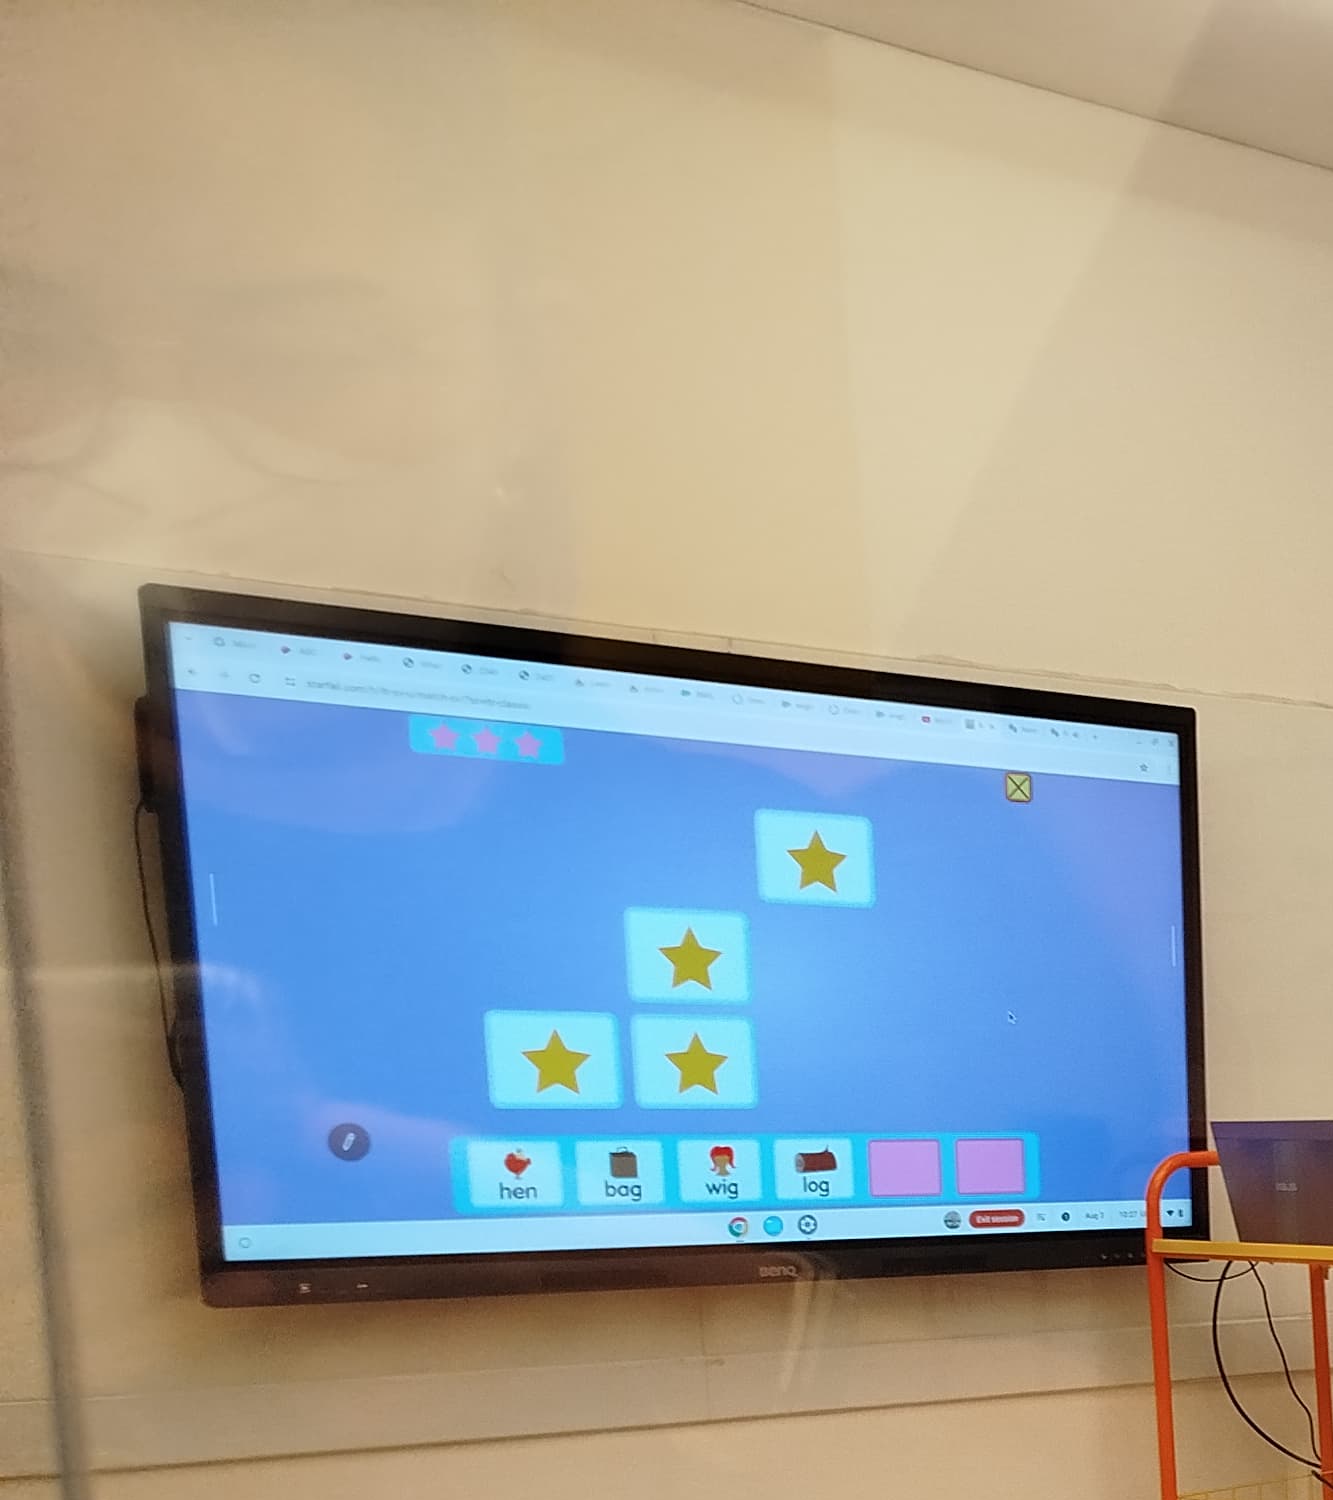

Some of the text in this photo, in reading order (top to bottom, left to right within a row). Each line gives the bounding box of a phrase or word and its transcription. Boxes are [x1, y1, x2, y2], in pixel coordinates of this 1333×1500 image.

[499, 1181, 538, 1200] hen
[604, 1180, 643, 1202] bag
[705, 1178, 739, 1200] wig
[802, 1175, 830, 1198] log
